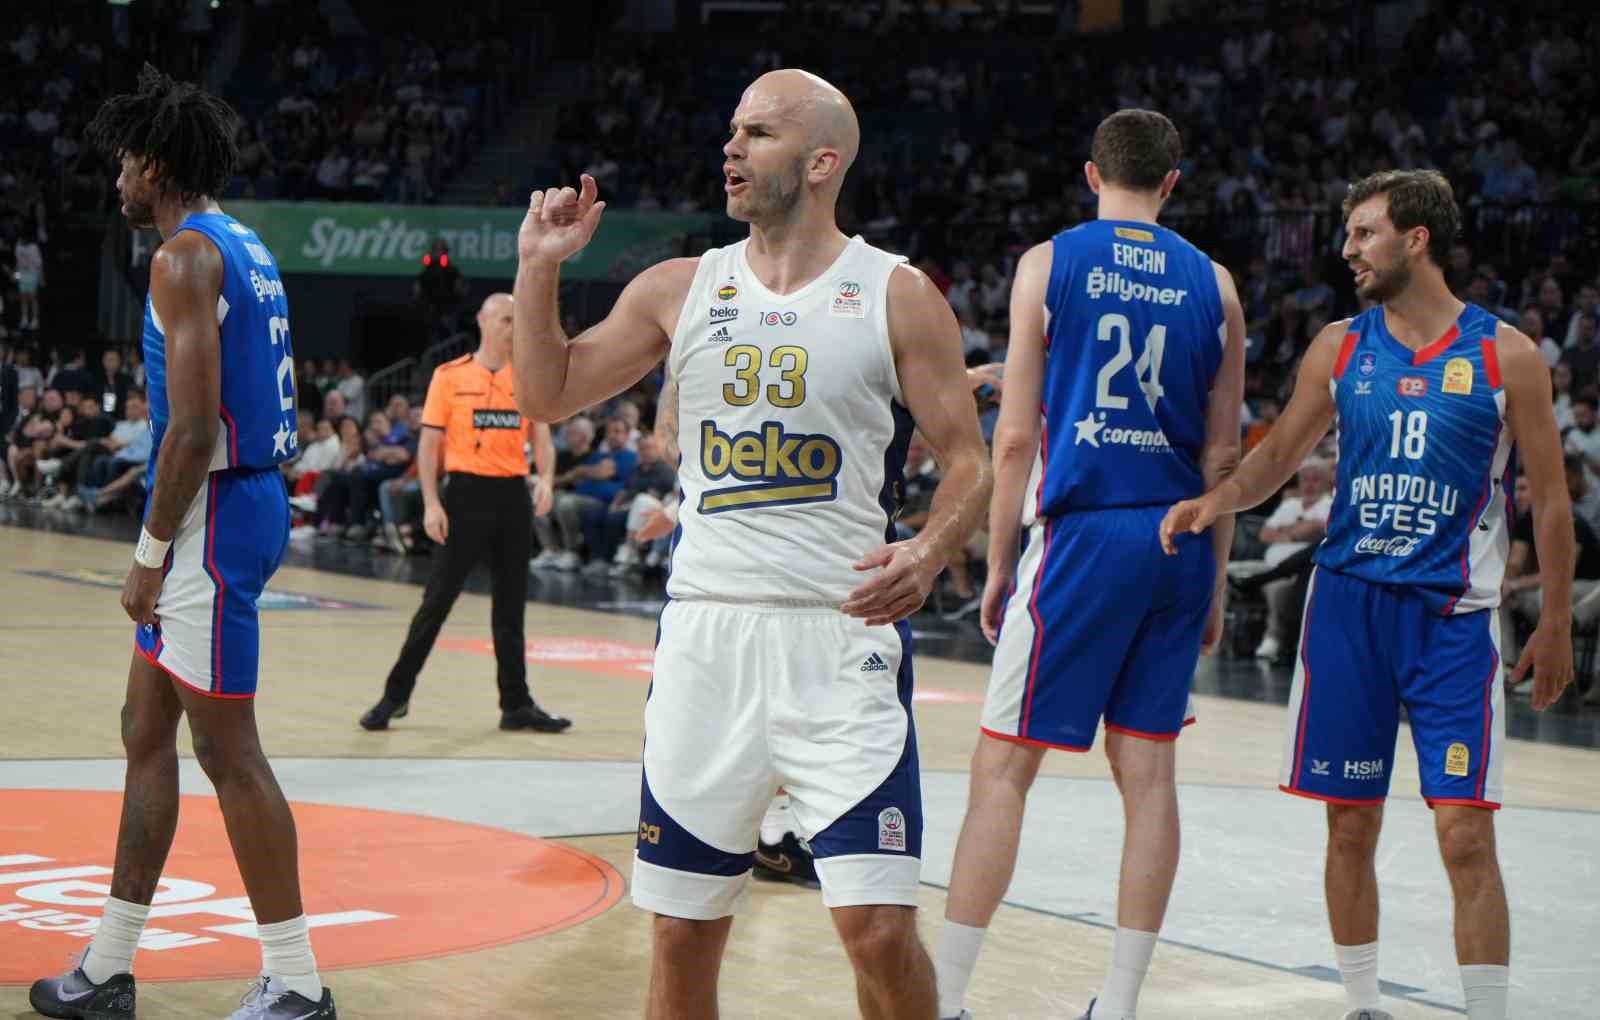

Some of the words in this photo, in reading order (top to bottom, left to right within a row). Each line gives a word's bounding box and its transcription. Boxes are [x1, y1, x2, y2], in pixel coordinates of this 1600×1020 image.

[303, 216, 428, 267] Sprite
[1112, 242, 1166, 275] ERCAN
[1086, 266, 1188, 306] Bilyoner
[709, 306, 739, 318] beko
[722, 344, 809, 409] 33
[1096, 313, 1167, 415] 24
[700, 419, 843, 482] beko
[1388, 409, 1428, 460] 18
[1351, 473, 1458, 516] ANADOLU
[1359, 503, 1438, 536] EFES
[860, 662, 889, 673] adidas
[1344, 759, 1384, 775] HSM
